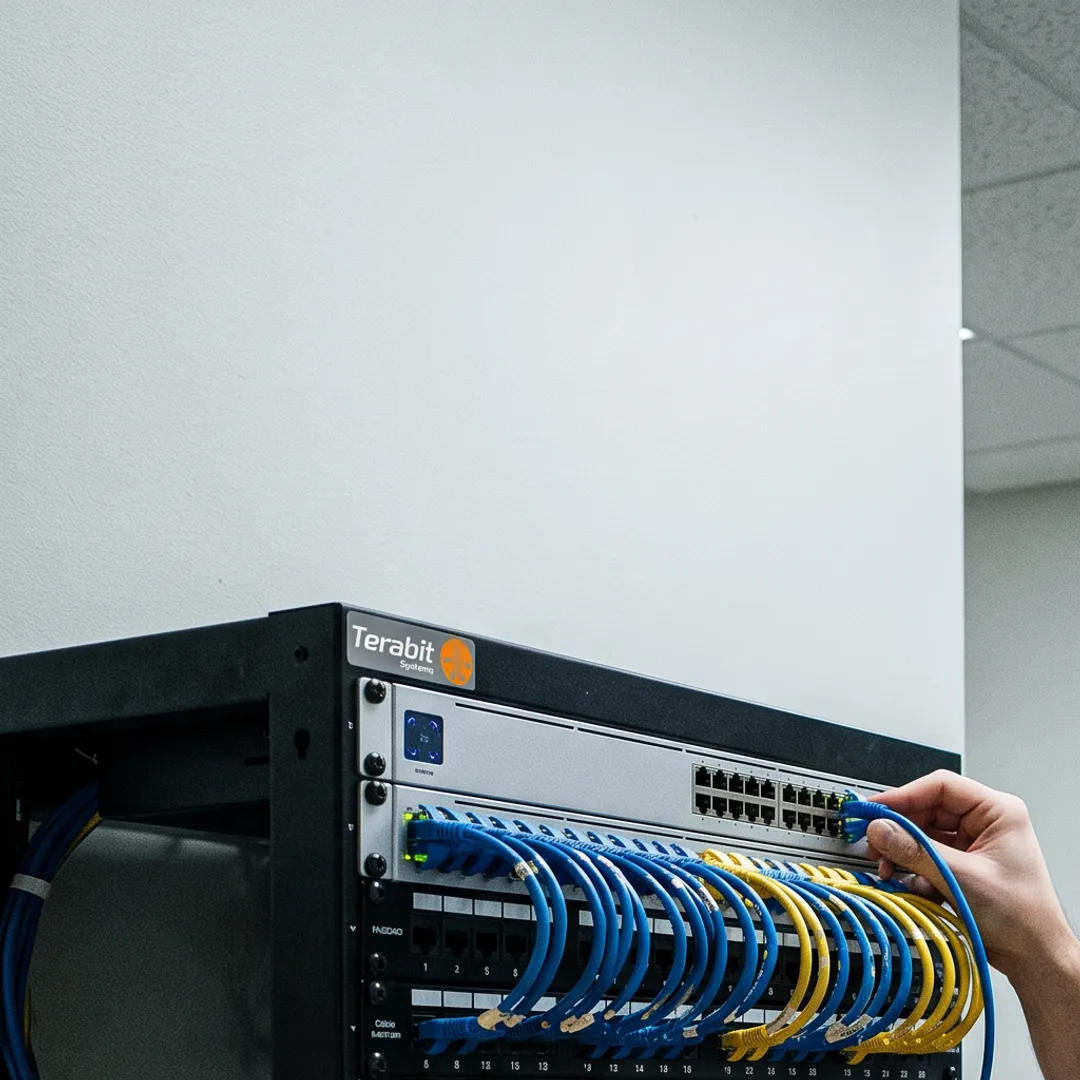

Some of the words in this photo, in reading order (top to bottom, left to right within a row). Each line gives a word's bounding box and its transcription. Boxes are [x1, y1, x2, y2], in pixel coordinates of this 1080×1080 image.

[352, 624, 435, 663] Terabit
[423, 962, 428, 972] 1
[454, 964, 460, 974] 2
